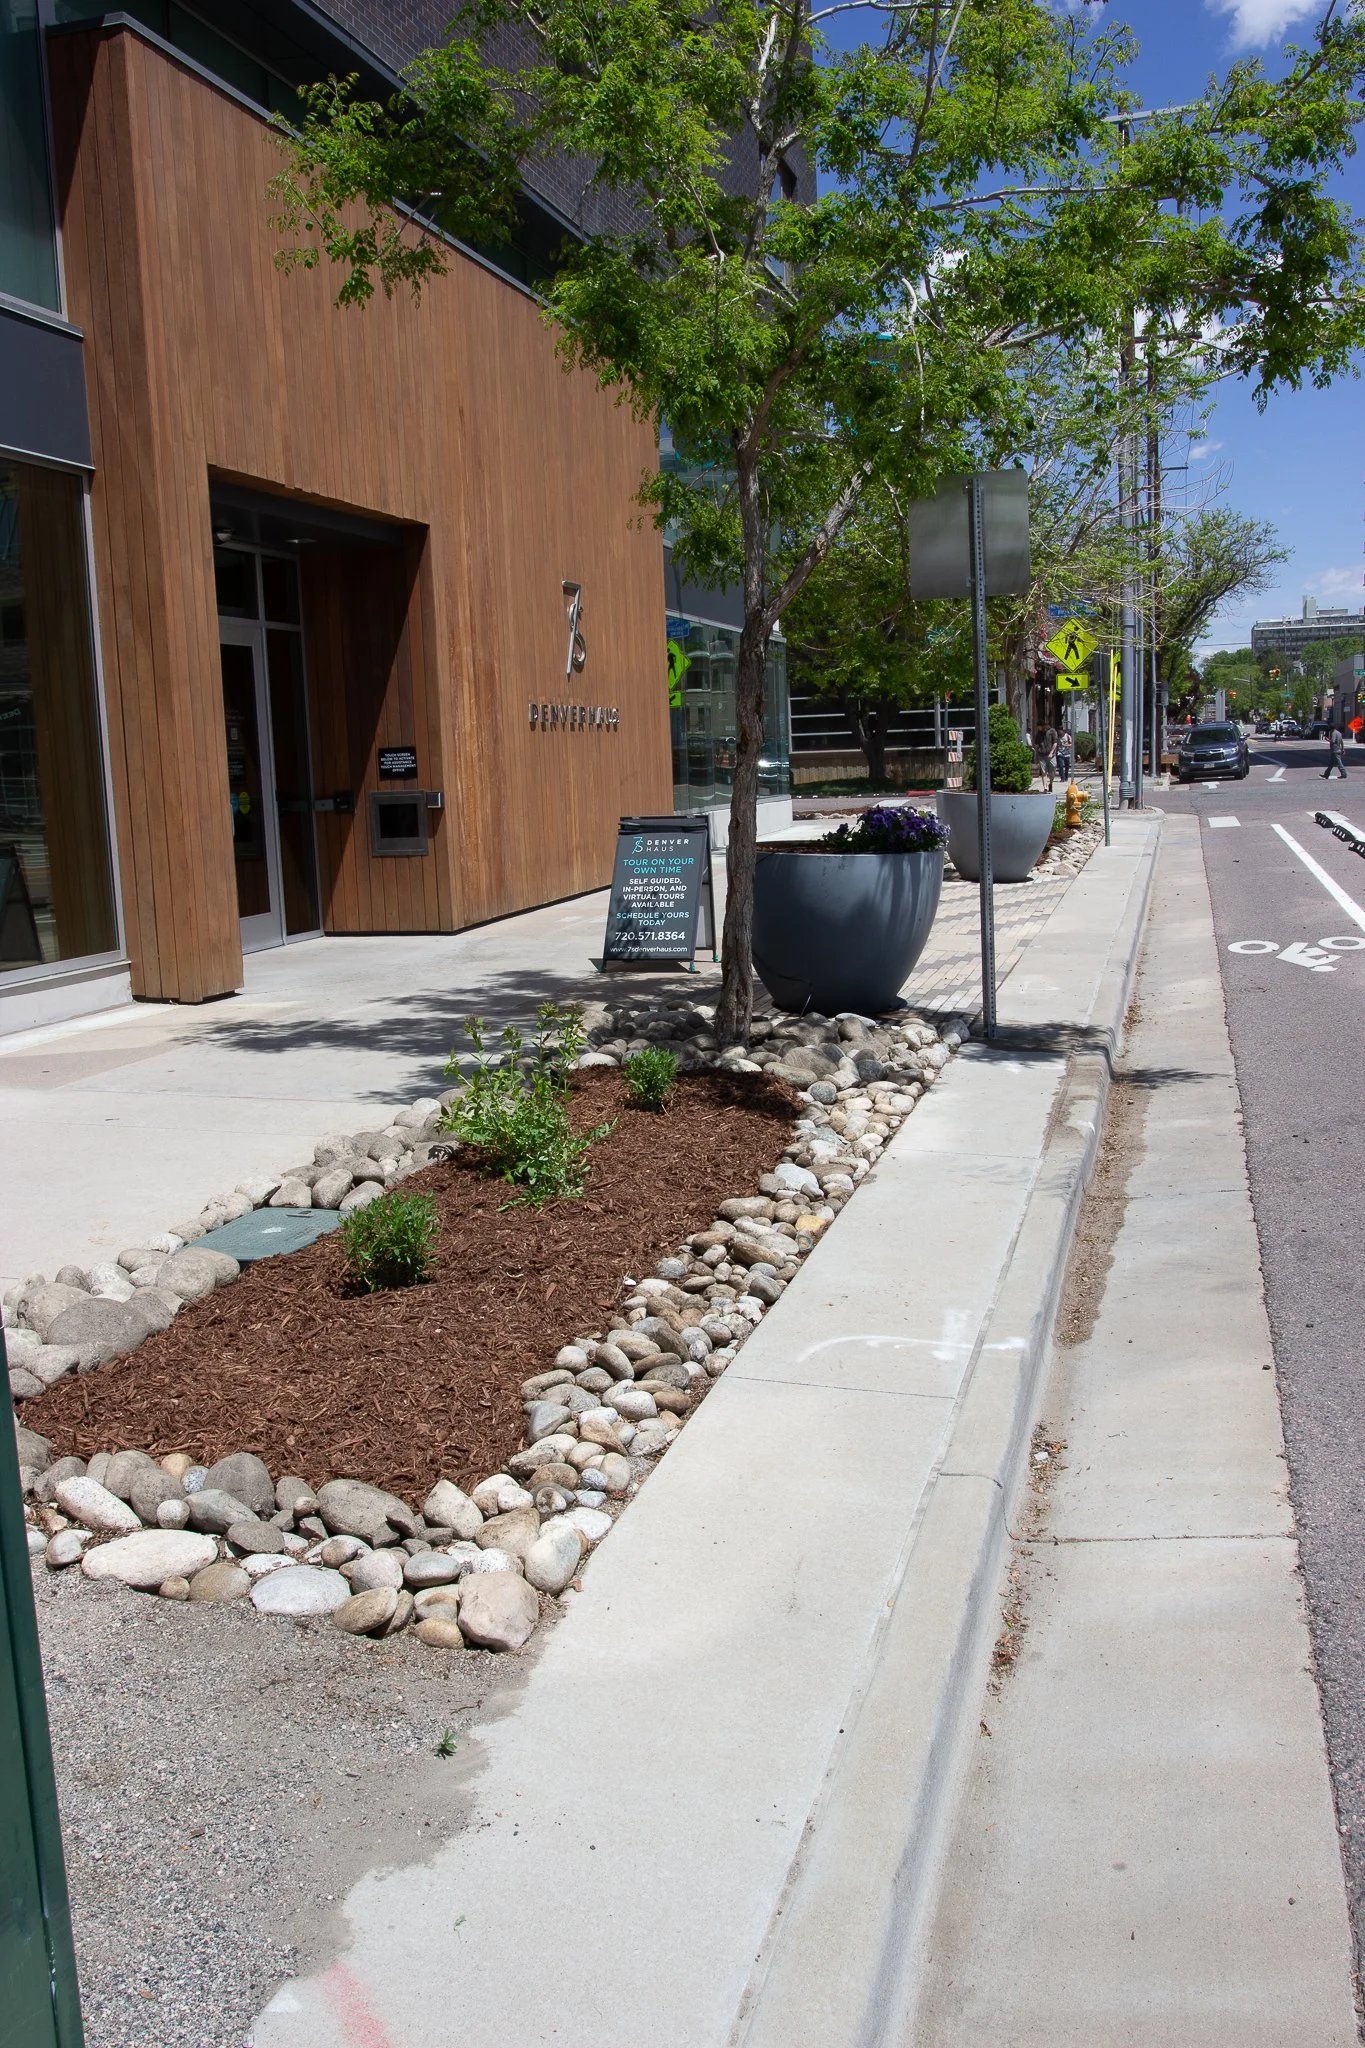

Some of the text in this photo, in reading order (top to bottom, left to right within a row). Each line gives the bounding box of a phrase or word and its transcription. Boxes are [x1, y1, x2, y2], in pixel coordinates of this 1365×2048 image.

[647, 838, 689, 846] DENVER
[623, 857, 695, 867] TOUR ON YOUR
[650, 877, 682, 885] GUIDED,
[622, 885, 668, 893] IN-PERSON,
[661, 911, 690, 919] YOURS
[615, 931, 686, 941] 720.571.8364
